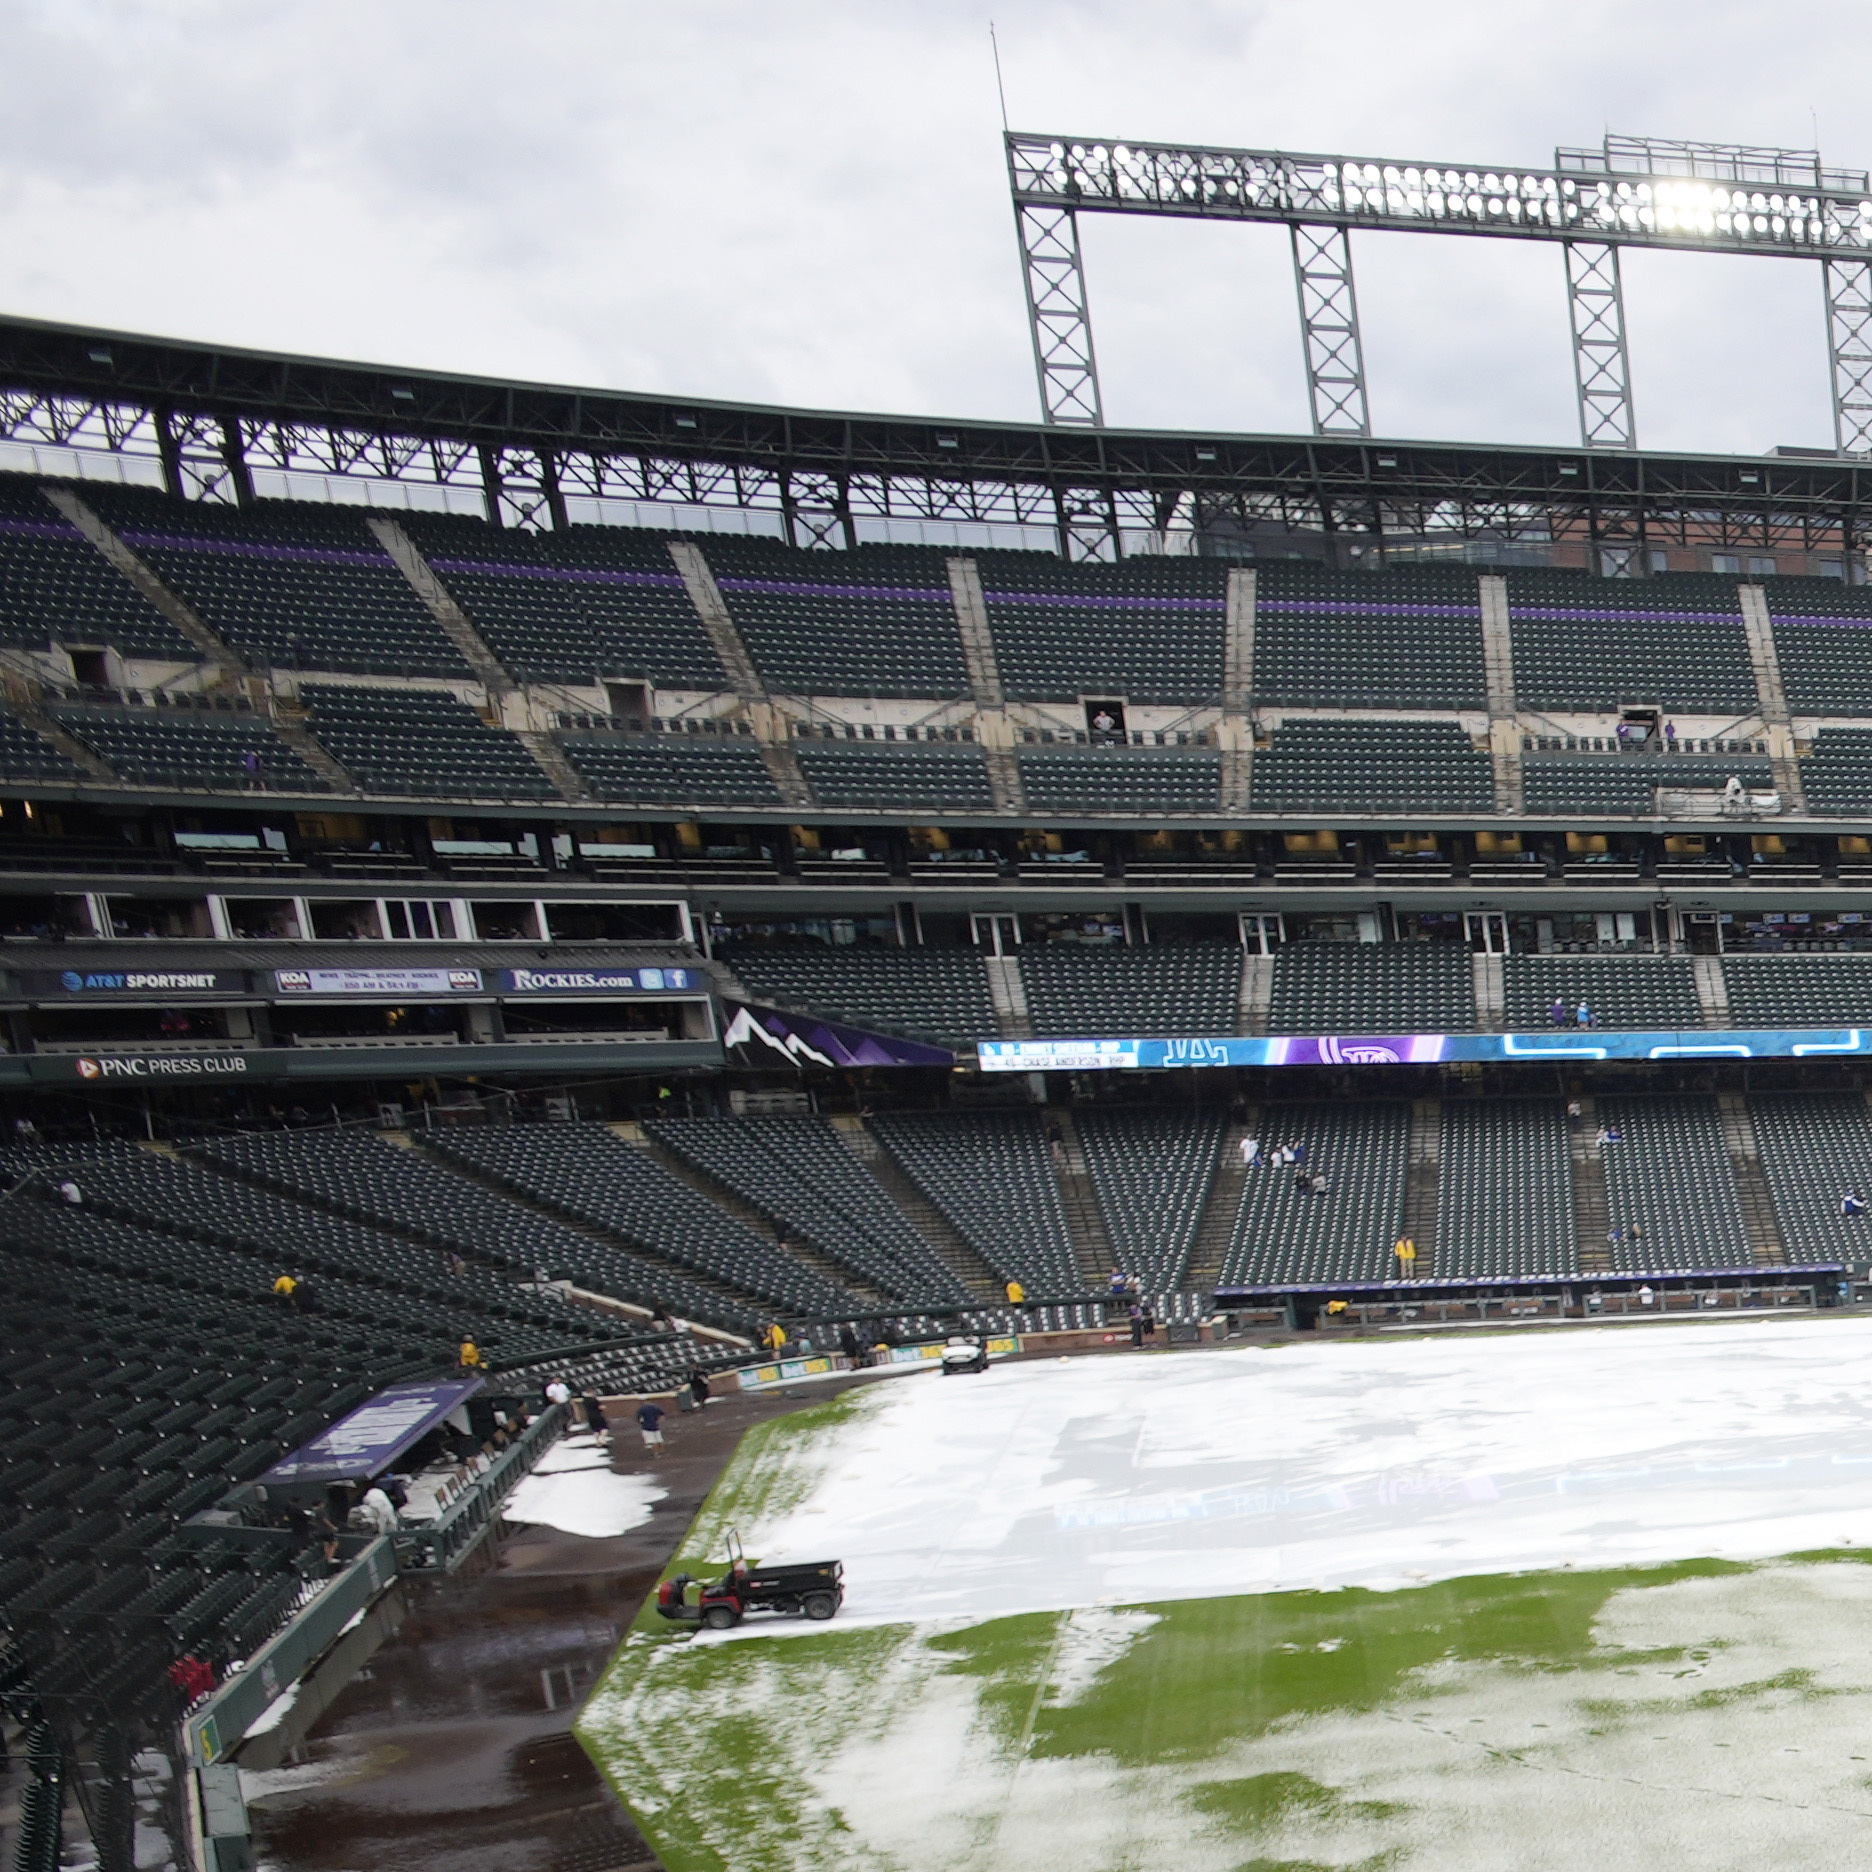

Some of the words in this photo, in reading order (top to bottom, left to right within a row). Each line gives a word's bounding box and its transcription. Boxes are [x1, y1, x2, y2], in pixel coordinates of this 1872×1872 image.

[85, 974, 125, 988] AT&T
[126, 974, 217, 988] SPORTSNET
[279, 971, 309, 984] KOA
[449, 971, 478, 983] KOA
[511, 968, 635, 991] ROCKIES.com
[99, 1058, 148, 1076] PNC
[150, 1058, 201, 1074] PRESS
[202, 1056, 247, 1073] CLUB
